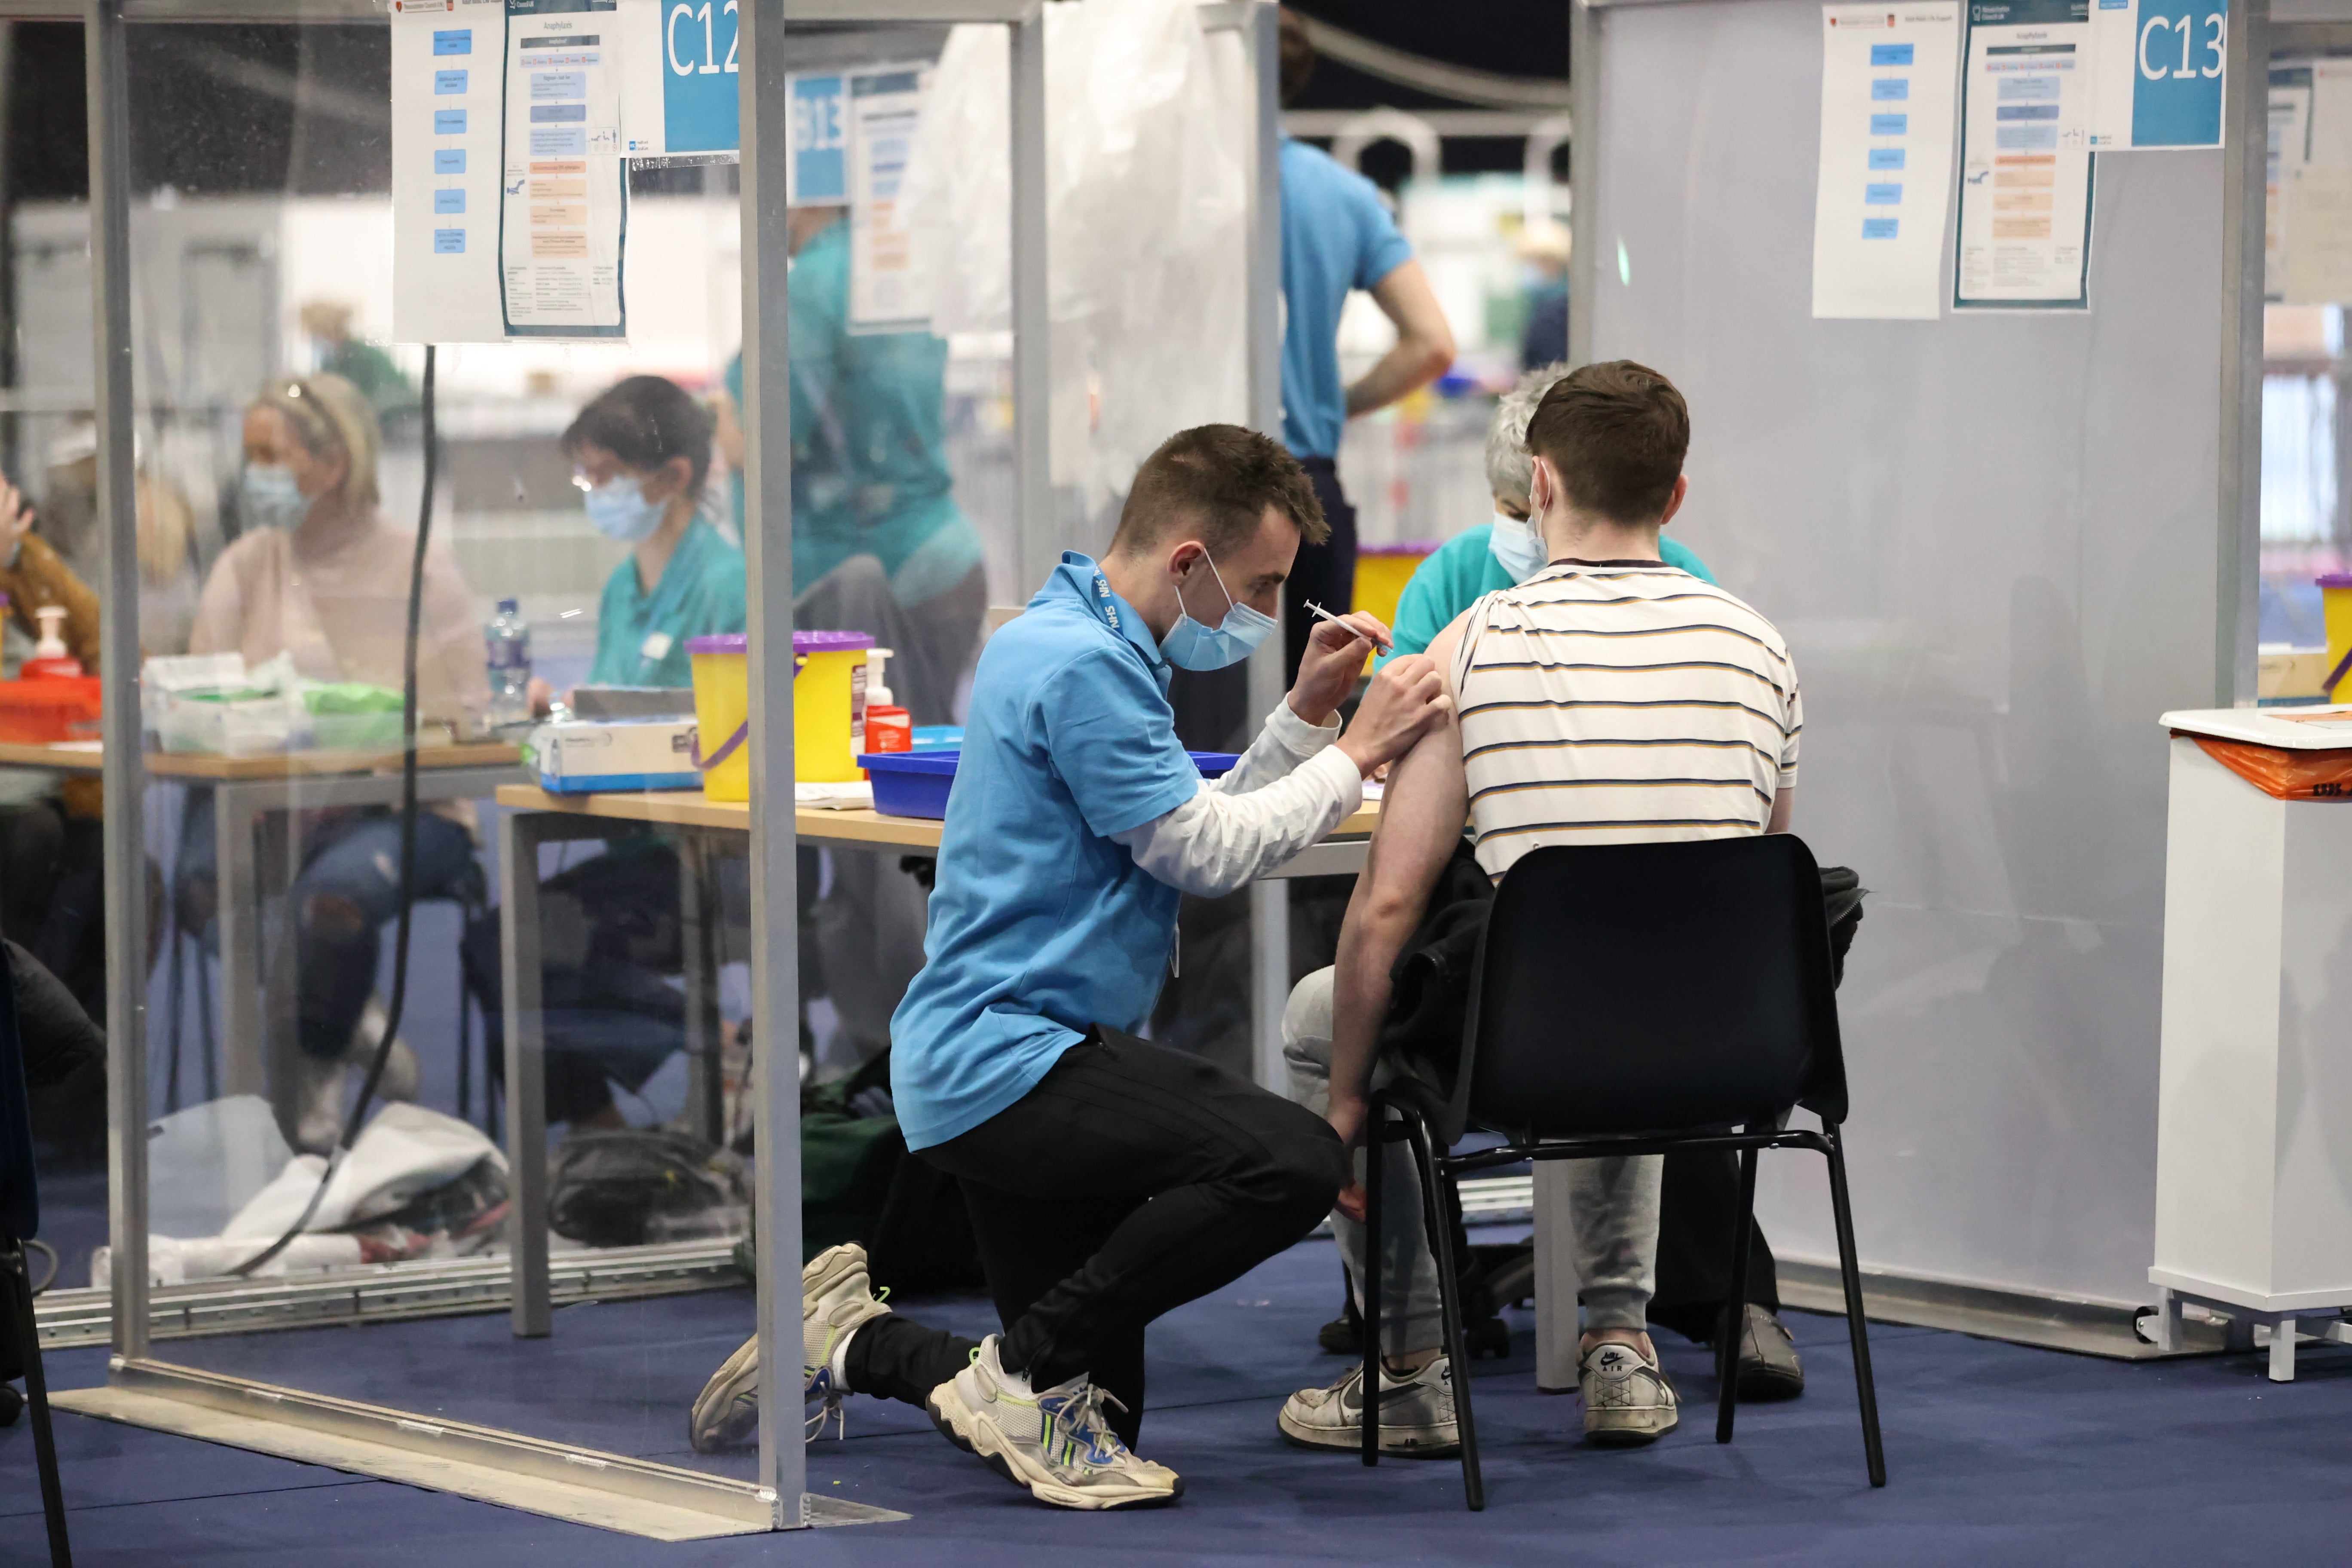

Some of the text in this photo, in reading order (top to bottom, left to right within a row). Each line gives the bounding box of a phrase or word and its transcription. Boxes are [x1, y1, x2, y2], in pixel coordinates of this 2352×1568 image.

[544, 21, 572, 31] Anaphylaxis
[668, 0, 738, 76] C12
[2139, 13, 2225, 80] C13
[1096, 579, 1110, 597] NHS
[1105, 605, 1120, 628] NHS
